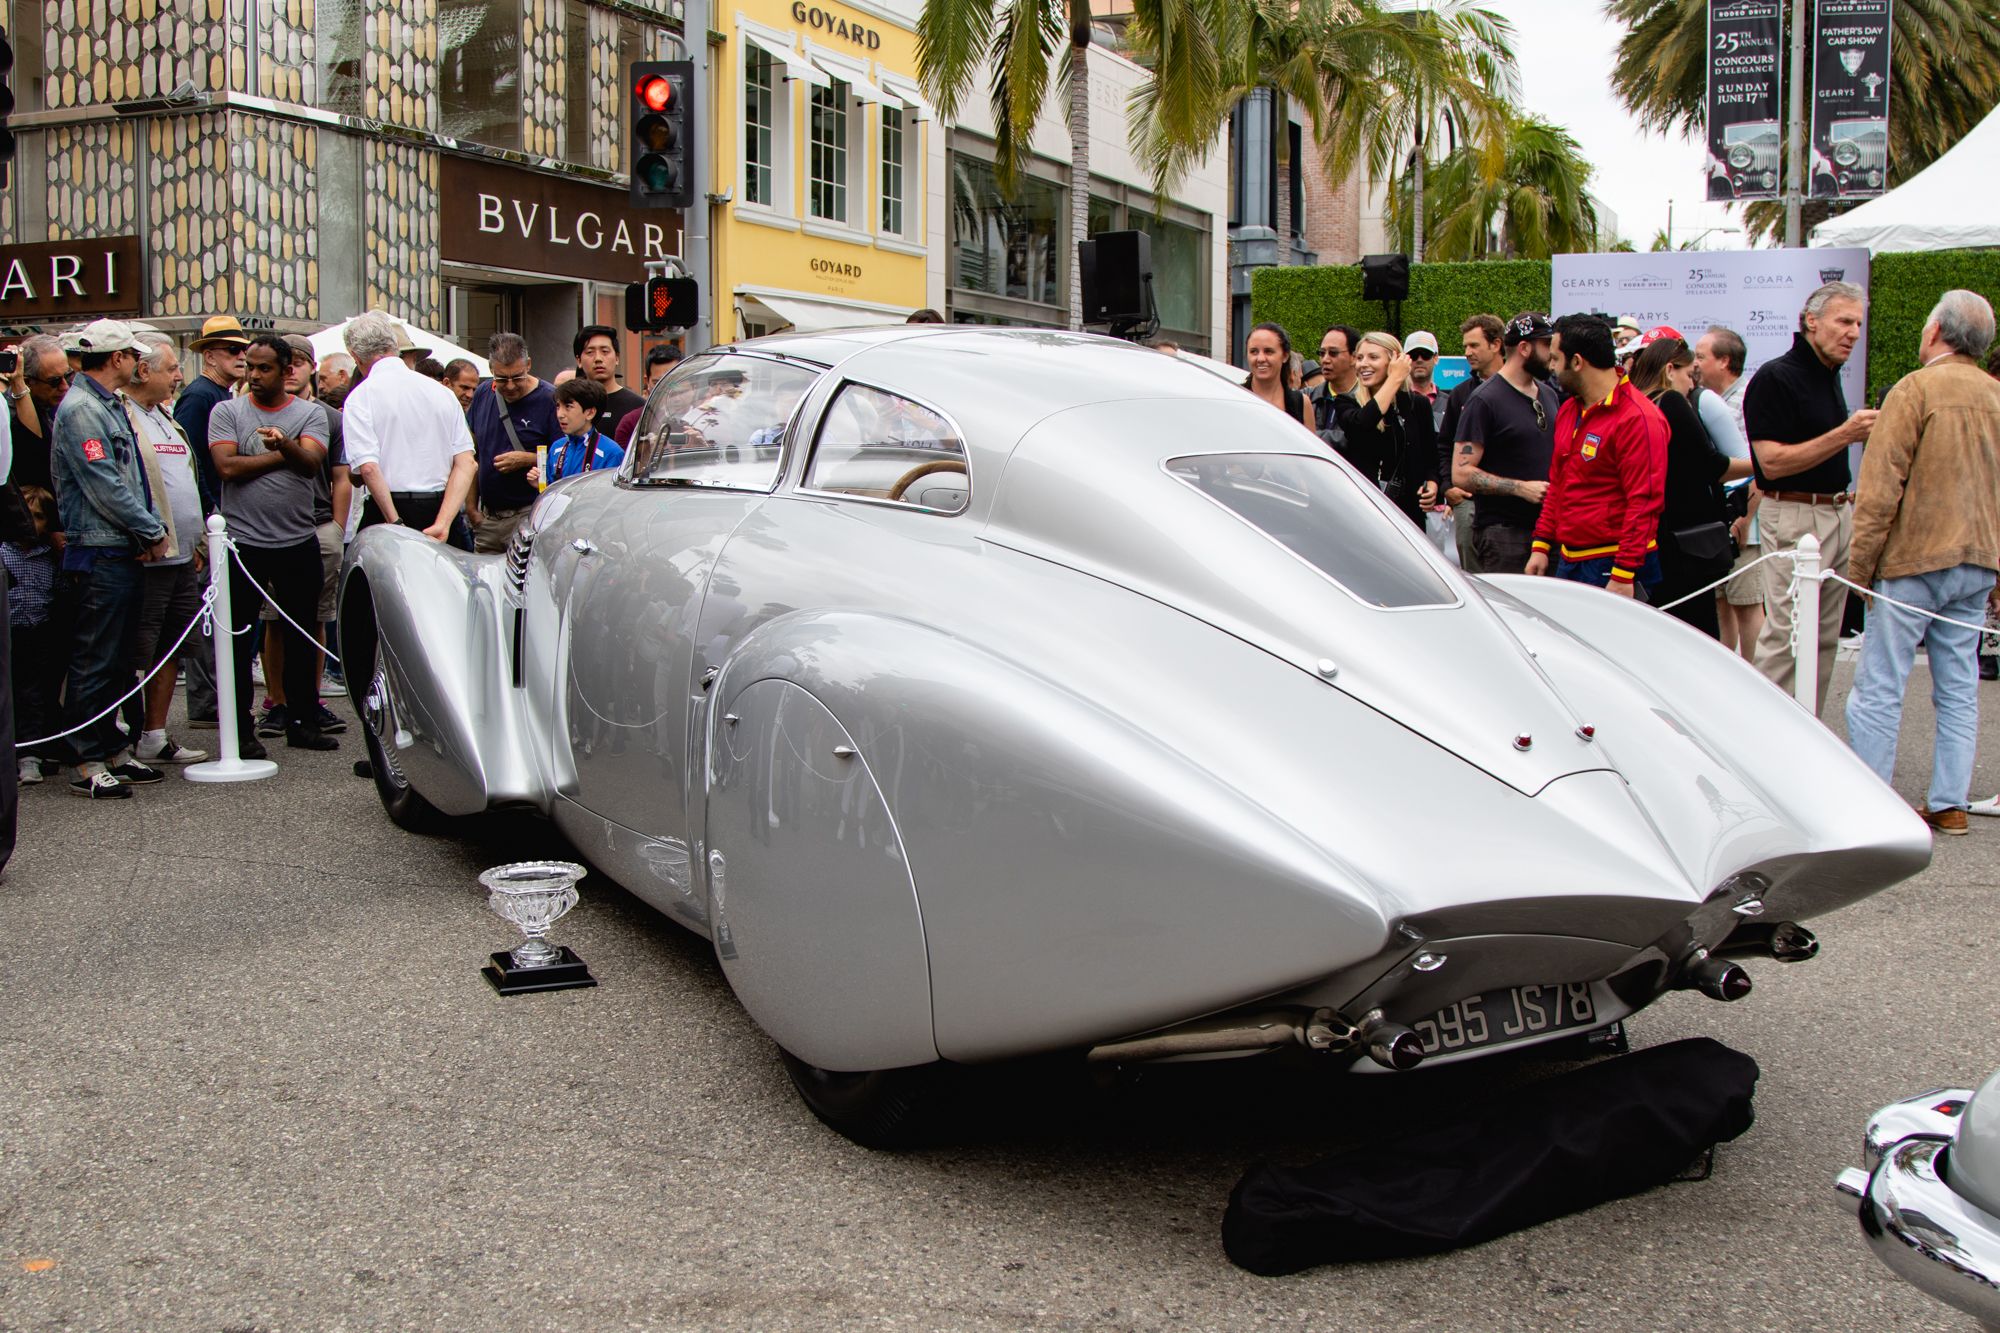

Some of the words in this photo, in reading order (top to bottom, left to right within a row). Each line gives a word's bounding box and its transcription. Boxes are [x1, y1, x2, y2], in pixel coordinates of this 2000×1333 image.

[1718, 10, 1746, 18] RODEO
[792, 1, 881, 50] GOYARD
[1822, 27, 1863, 36] FATHER'S
[1864, 26, 1884, 35] DAY
[1739, 38, 1774, 47] ANNUAL
[1827, 37, 1847, 46] CAR
[1847, 36, 1877, 45] SHOW
[1714, 54, 1775, 66] CONCOURS
[1714, 65, 1774, 75] D'ELEGANCE
[1717, 82, 1769, 93] SUNDAY
[1818, 88, 1855, 98] GEARYS
[1717, 94, 1743, 105] JUNE
[478, 193, 685, 261] BVLGARI
[810, 258, 862, 278] GOYARD
[0, 252, 118, 300] ARI
[1744, 275, 1793, 284] O'GARA
[1561, 279, 1610, 288] GEARYS
